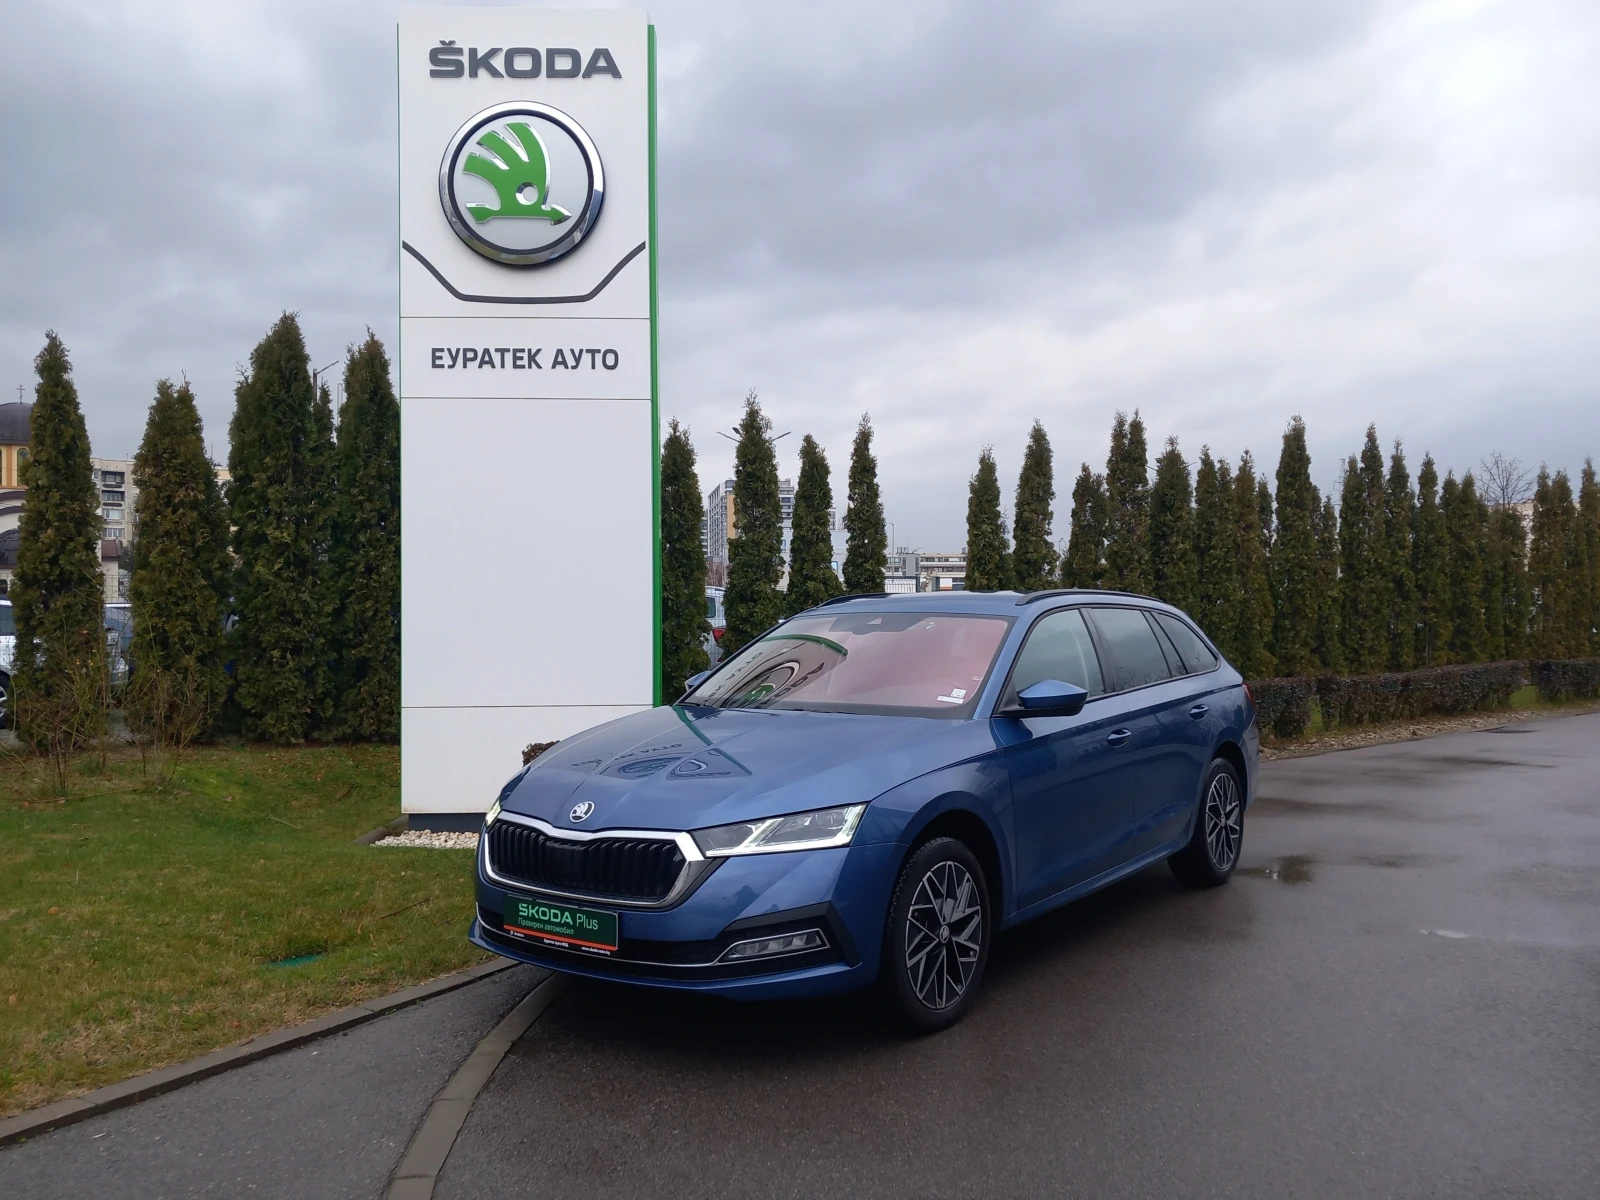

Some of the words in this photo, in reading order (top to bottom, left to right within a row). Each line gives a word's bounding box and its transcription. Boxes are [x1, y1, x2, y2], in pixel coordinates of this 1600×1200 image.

[428, 40, 623, 79] ŠKODA
[430, 347, 543, 369] ЕУРАТЕК
[551, 348, 620, 370] АУТО
[518, 917, 544, 929] Проверен
[544, 923, 574, 934] автомобил
[576, 913, 598, 930] Plus
